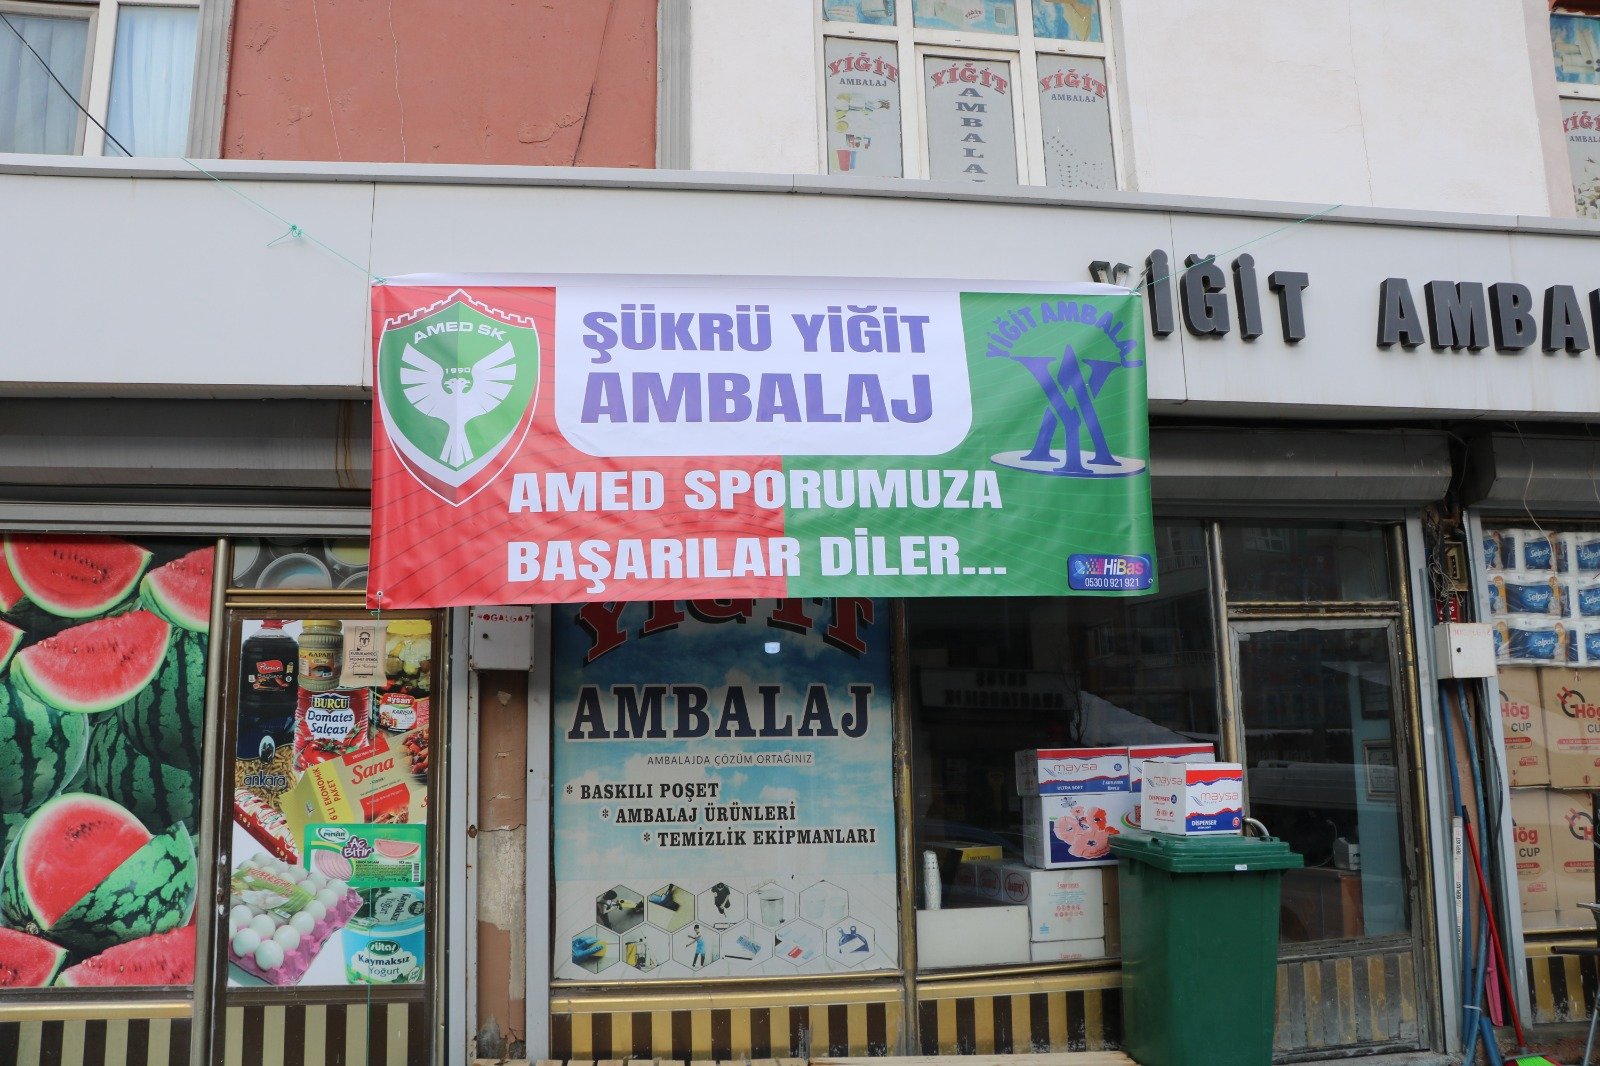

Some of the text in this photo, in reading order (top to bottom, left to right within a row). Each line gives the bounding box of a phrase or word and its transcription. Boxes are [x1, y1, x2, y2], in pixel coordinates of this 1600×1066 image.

[839, 77, 887, 87] AMBALAJ
[931, 63, 1008, 95] YİĞİT
[1040, 69, 1106, 99] YİĞİT
[1051, 93, 1096, 103] AMBALAJ
[955, 87, 988, 183] AMBALA
[1377, 277, 1600, 355] AMBA
[414, 321, 507, 344] AMED SK
[582, 303, 930, 364] ŞÜKRÜ YİĞİT
[986, 300, 1143, 368] YİĞİT AMBALAJ
[445, 367, 471, 375] 1990
[581, 372, 933, 423] AMBALAJ
[508, 469, 1003, 513] AMED SPORUMUZA
[1530, 548, 1550, 558] Selpak
[507, 536, 801, 593] BAŞARILAR
[1085, 577, 1103, 588] 0530
[1110, 578, 1123, 588] 921
[1125, 577, 1139, 587] 921
[1527, 592, 1550, 602] Selpak
[1534, 637, 1555, 648] Selpak
[314, 697, 348, 708] BURCU
[307, 710, 353, 722] Domates
[567, 685, 873, 739] AMBALAJ
[311, 723, 348, 736] Salçası
[1511, 722, 1532, 732] CUP
[647, 753, 812, 767] AMBALAJDA ÇÖZÜM ORTAĞINIZ
[351, 757, 395, 785] Sana
[1053, 763, 1098, 773] maysa
[244, 770, 287, 788] ankara
[1153, 776, 1183, 786] maysa
[327, 779, 341, 802] PAKET
[580, 782, 719, 803] BASKILI POŞET
[1200, 791, 1239, 803] maysa
[615, 801, 796, 824] AMBALAJ ÜRÜNLERİ
[657, 825, 876, 847] TEMİZLİK EKİPMANLARI
[344, 846, 372, 858] Bitir
[1518, 847, 1540, 858] CUP
[358, 954, 411, 967] Kaymaksız
[368, 966, 400, 978] Yoğurt
